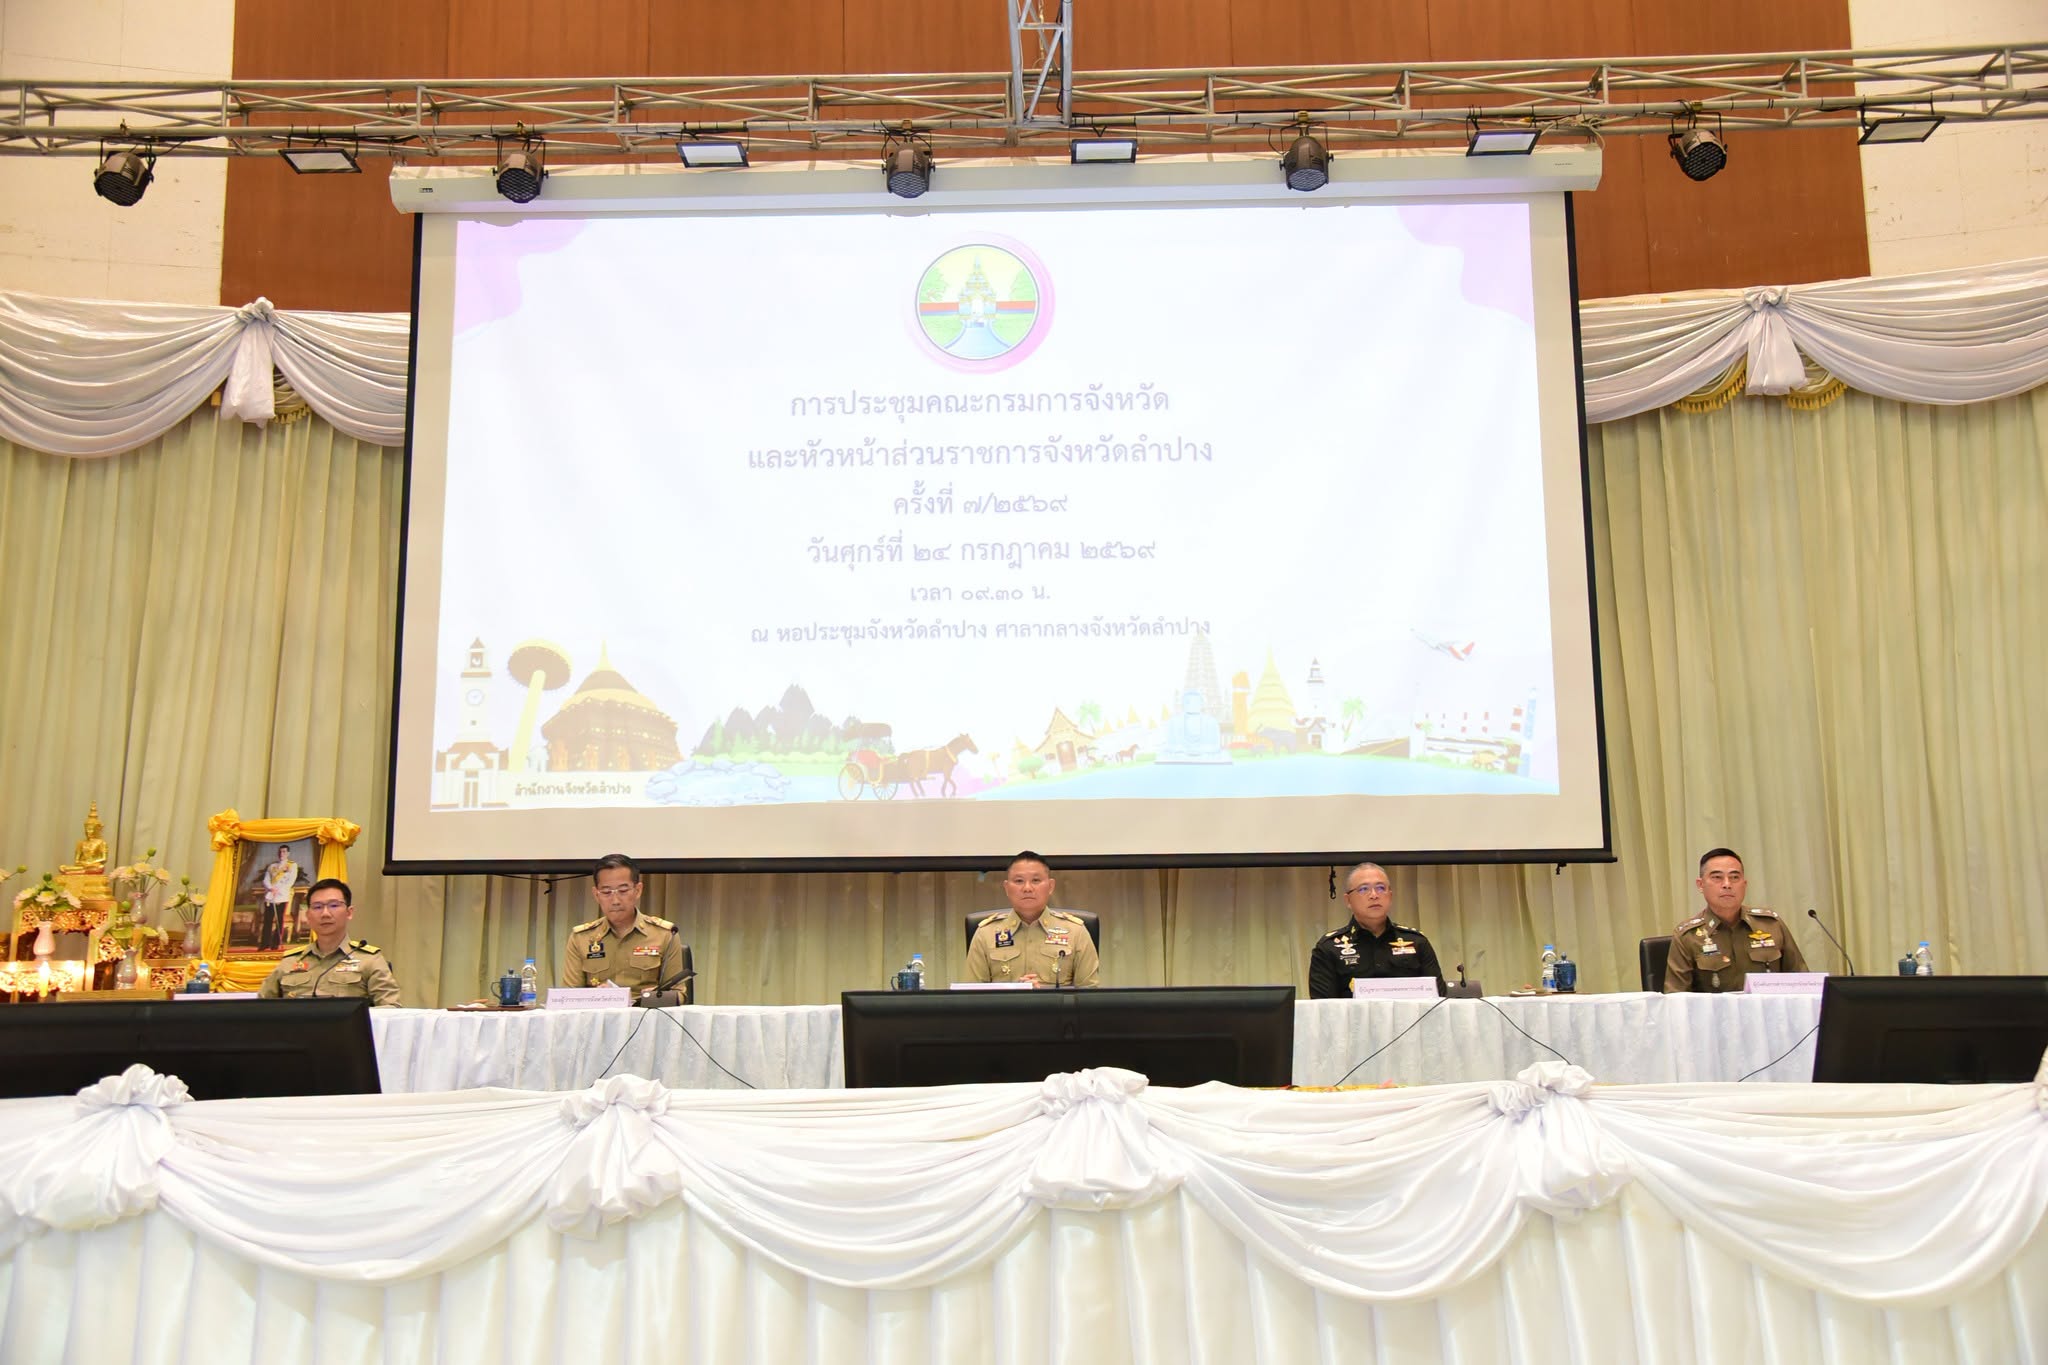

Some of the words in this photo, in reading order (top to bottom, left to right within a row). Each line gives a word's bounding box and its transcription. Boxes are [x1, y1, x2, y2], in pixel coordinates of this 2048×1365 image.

[790, 382, 1170, 424] การประชุมคณะกรมการจังหวัด
[748, 433, 1214, 469] และหัวหน้าส่วนราชการจังหวัดลำปาง
[893, 480, 954, 515] ครั้งที่
[962, 491, 1069, 514] ๗/๒๕๖๙
[807, 529, 904, 571] วันศุกร์ที่
[912, 543, 952, 562] ๒๔
[961, 541, 1070, 569] กรกฎาคม
[1079, 539, 1157, 560] ๒๕๖๙
[909, 584, 953, 602] เวลา
[960, 586, 1025, 601] ๐๙.๓๐
[1032, 584, 1051, 600] น.
[751, 626, 769, 643] ณ
[776, 618, 988, 648] หอประชุมจังหวัดลำปาง
[995, 616, 1211, 640] ศาลากลางจังหวัดลำปาง
